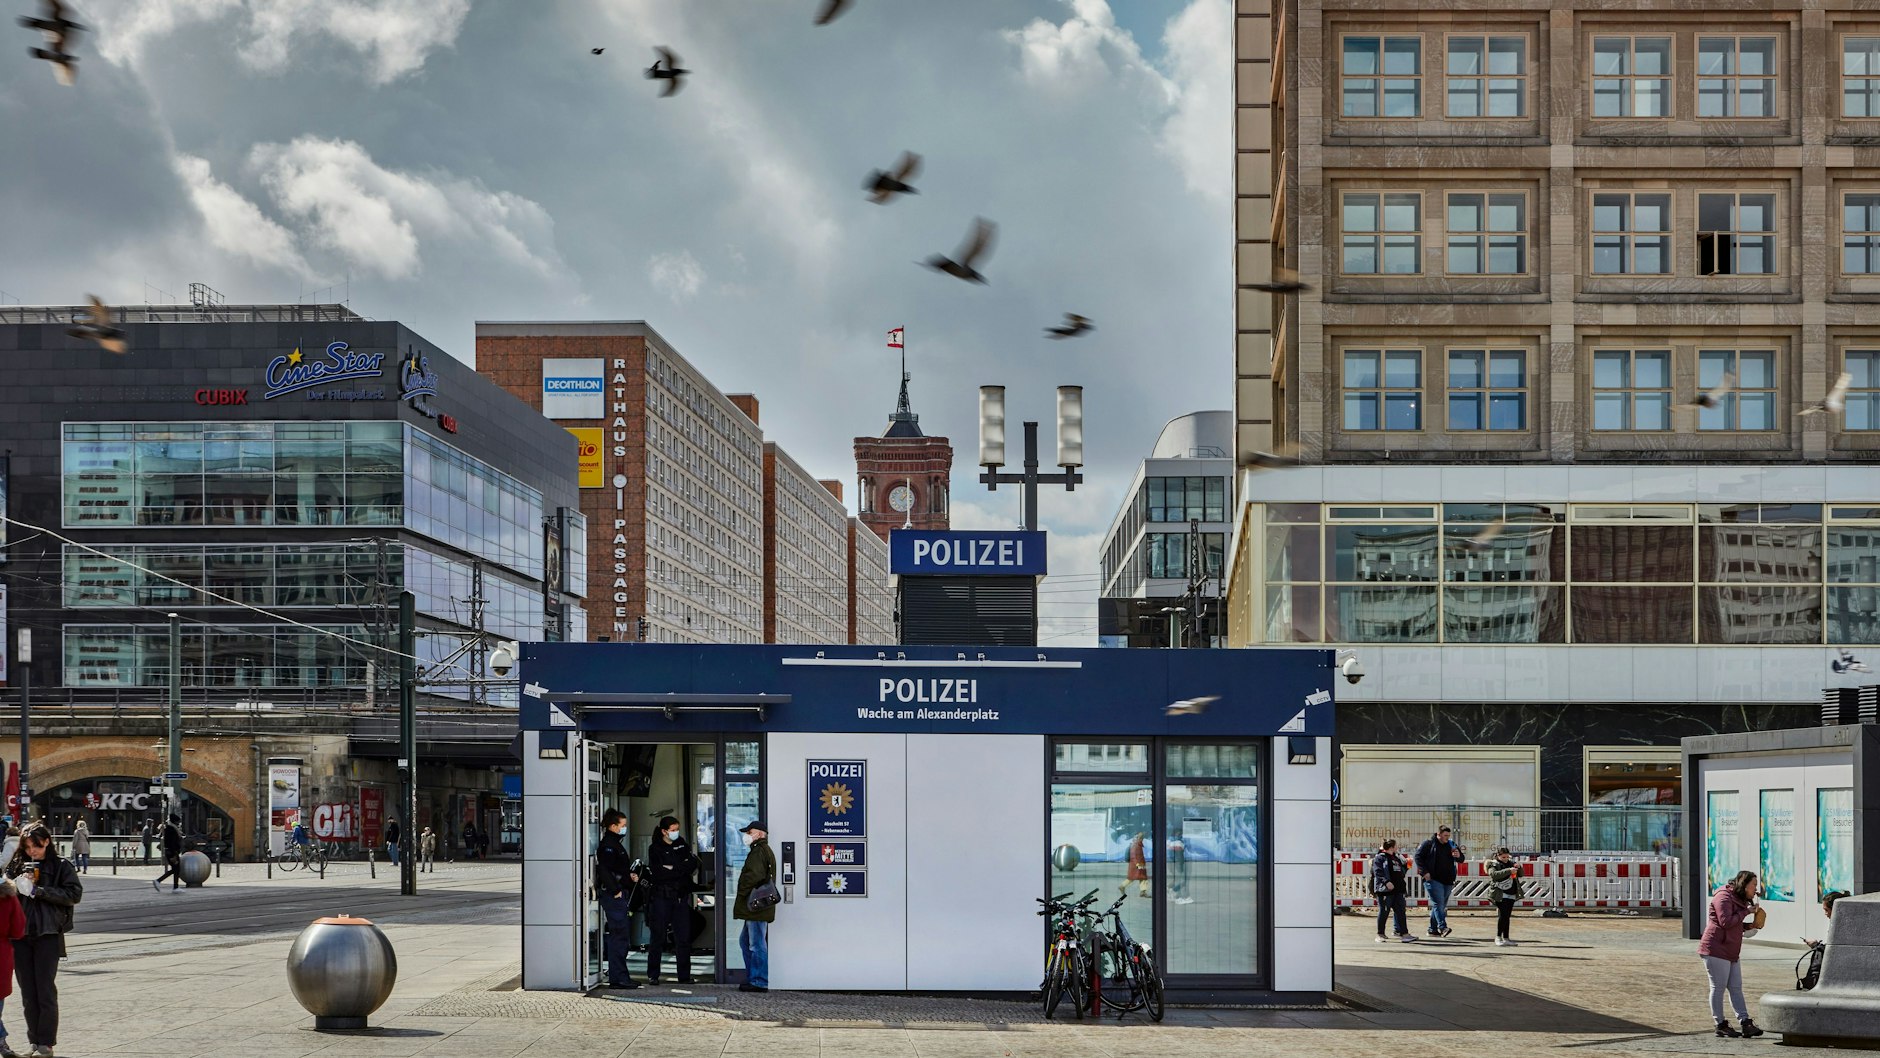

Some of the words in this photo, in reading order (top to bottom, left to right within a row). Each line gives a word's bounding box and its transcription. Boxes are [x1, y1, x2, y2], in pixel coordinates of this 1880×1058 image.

[265, 341, 384, 389] CineStar
[547, 380, 600, 390] DECATHLON
[194, 388, 248, 405] CUBIX
[613, 358, 627, 457] RATHAUS
[914, 540, 1024, 566] POLIZEI
[879, 679, 977, 703] POLIZEI
[857, 708, 894, 719] Wache
[897, 711, 914, 719] am
[917, 708, 999, 722] Alexanderplatz
[811, 765, 862, 777] POLIZEI
[101, 793, 150, 810] KFC
